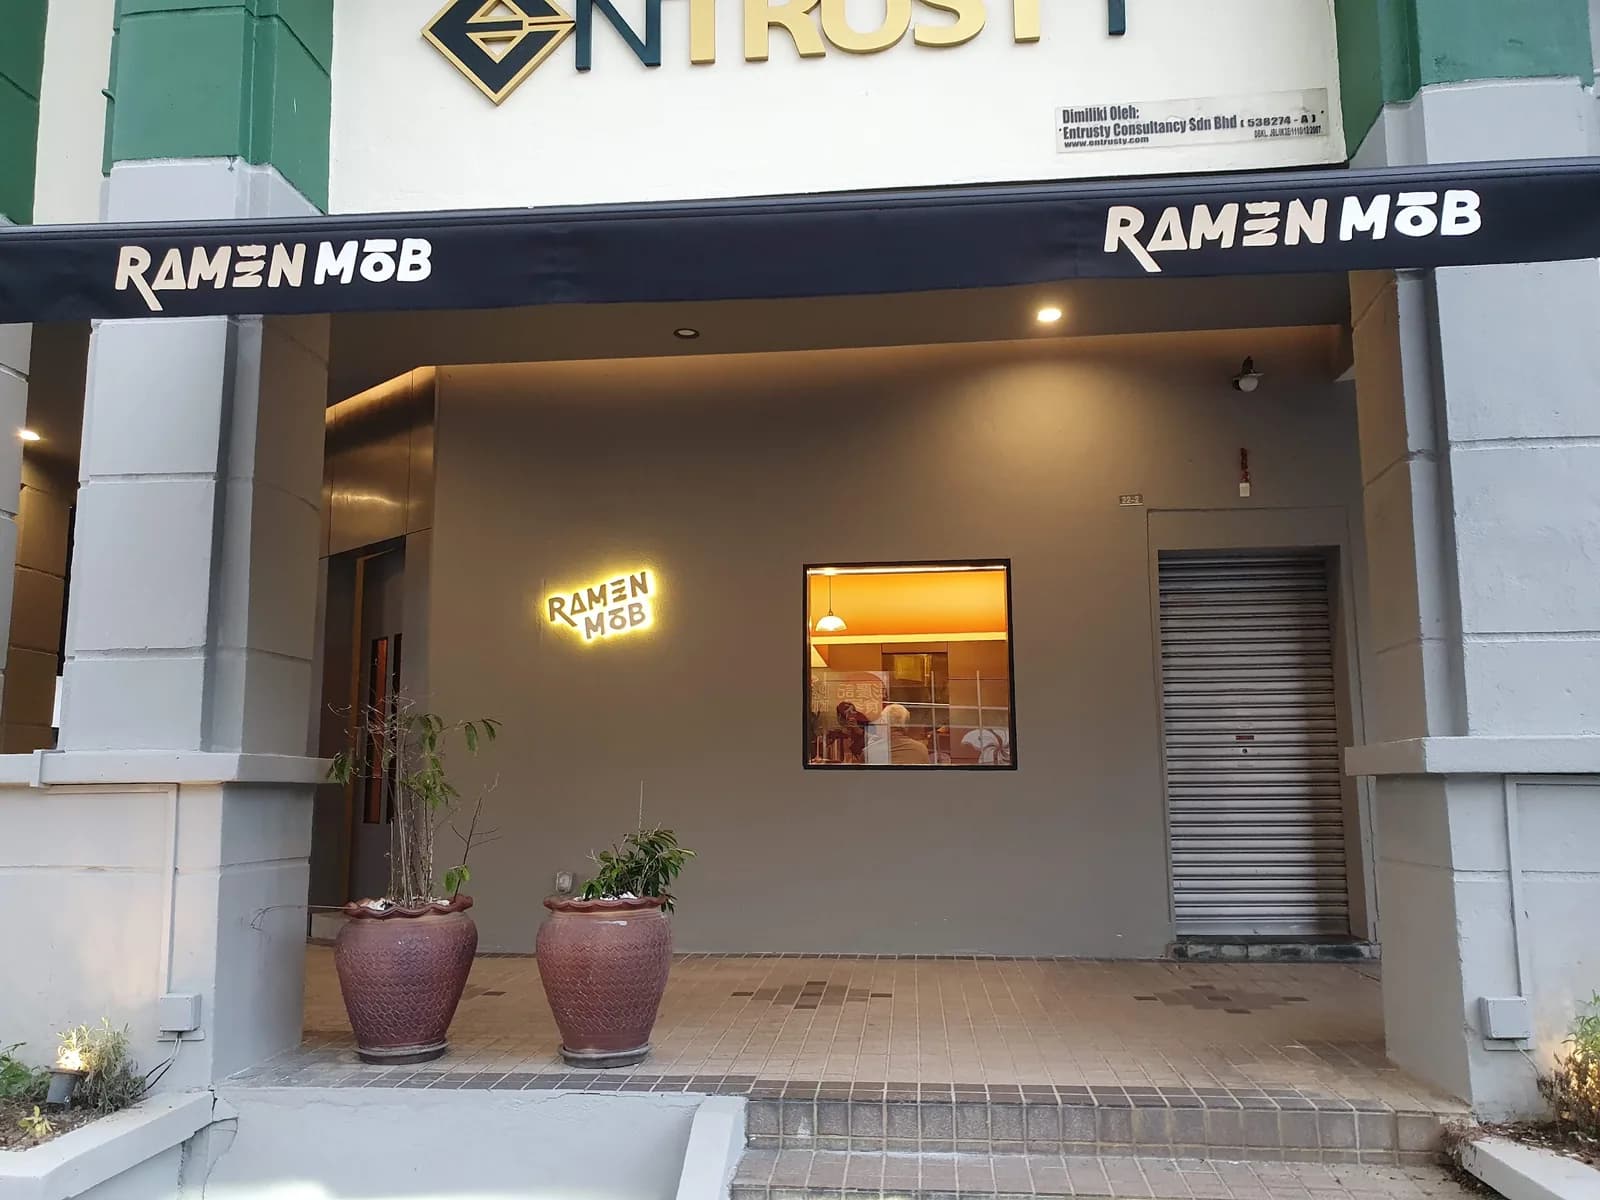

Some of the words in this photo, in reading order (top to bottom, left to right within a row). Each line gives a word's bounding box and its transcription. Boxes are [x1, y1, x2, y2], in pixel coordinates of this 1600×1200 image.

[1062, 106, 1107, 124] Dimiliki
[1109, 104, 1139, 121] Oleh:
[1063, 125, 1111, 140] Entrusty
[1113, 119, 1186, 137] Consultancy
[1189, 117, 1212, 132] Sdn
[1214, 114, 1237, 130] Bhd
[1064, 136, 1149, 148] www.entrusty.com
[1104, 197, 1328, 273] RAMEN
[114, 242, 307, 312] RAMEN
[548, 571, 648, 627] RAMEN
